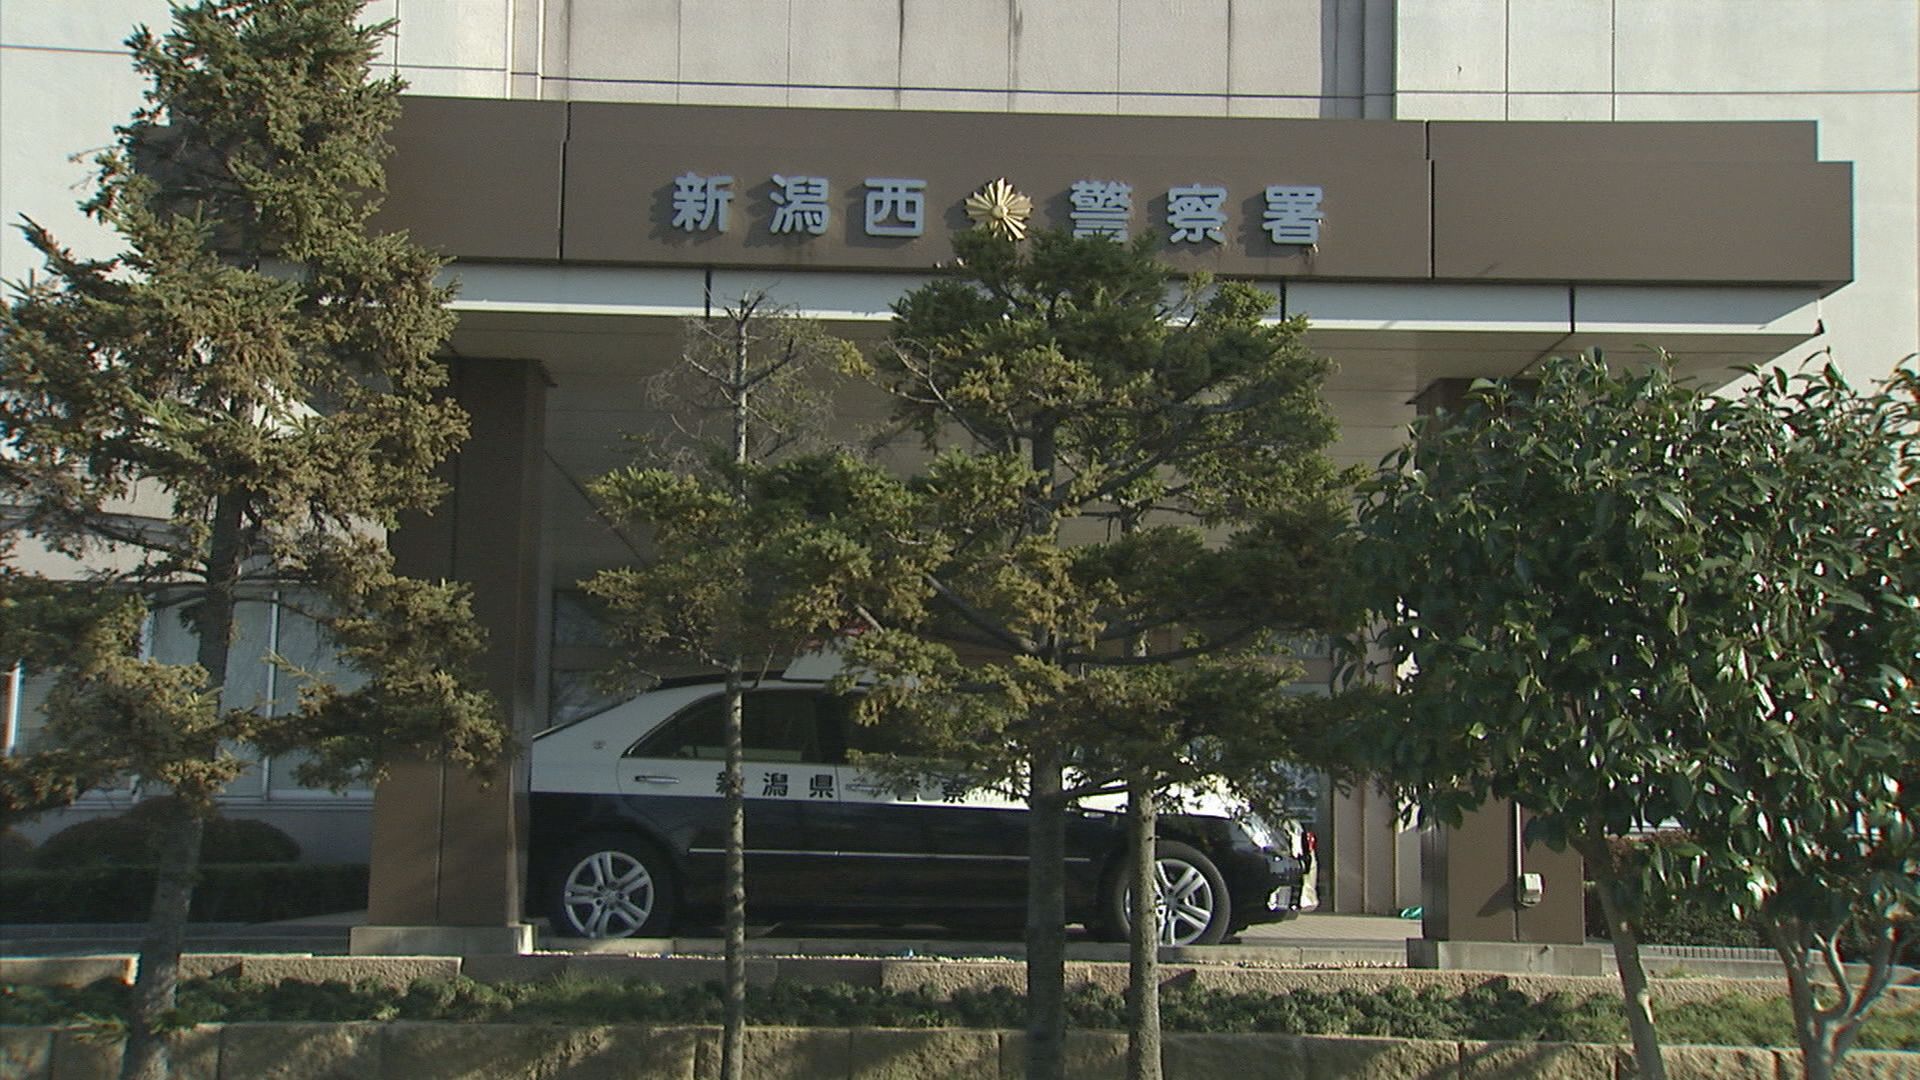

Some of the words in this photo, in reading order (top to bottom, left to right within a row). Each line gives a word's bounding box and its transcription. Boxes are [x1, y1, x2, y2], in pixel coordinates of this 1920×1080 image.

[672, 172, 927, 237] 新潟西
[1070, 180, 1325, 244] 警察署
